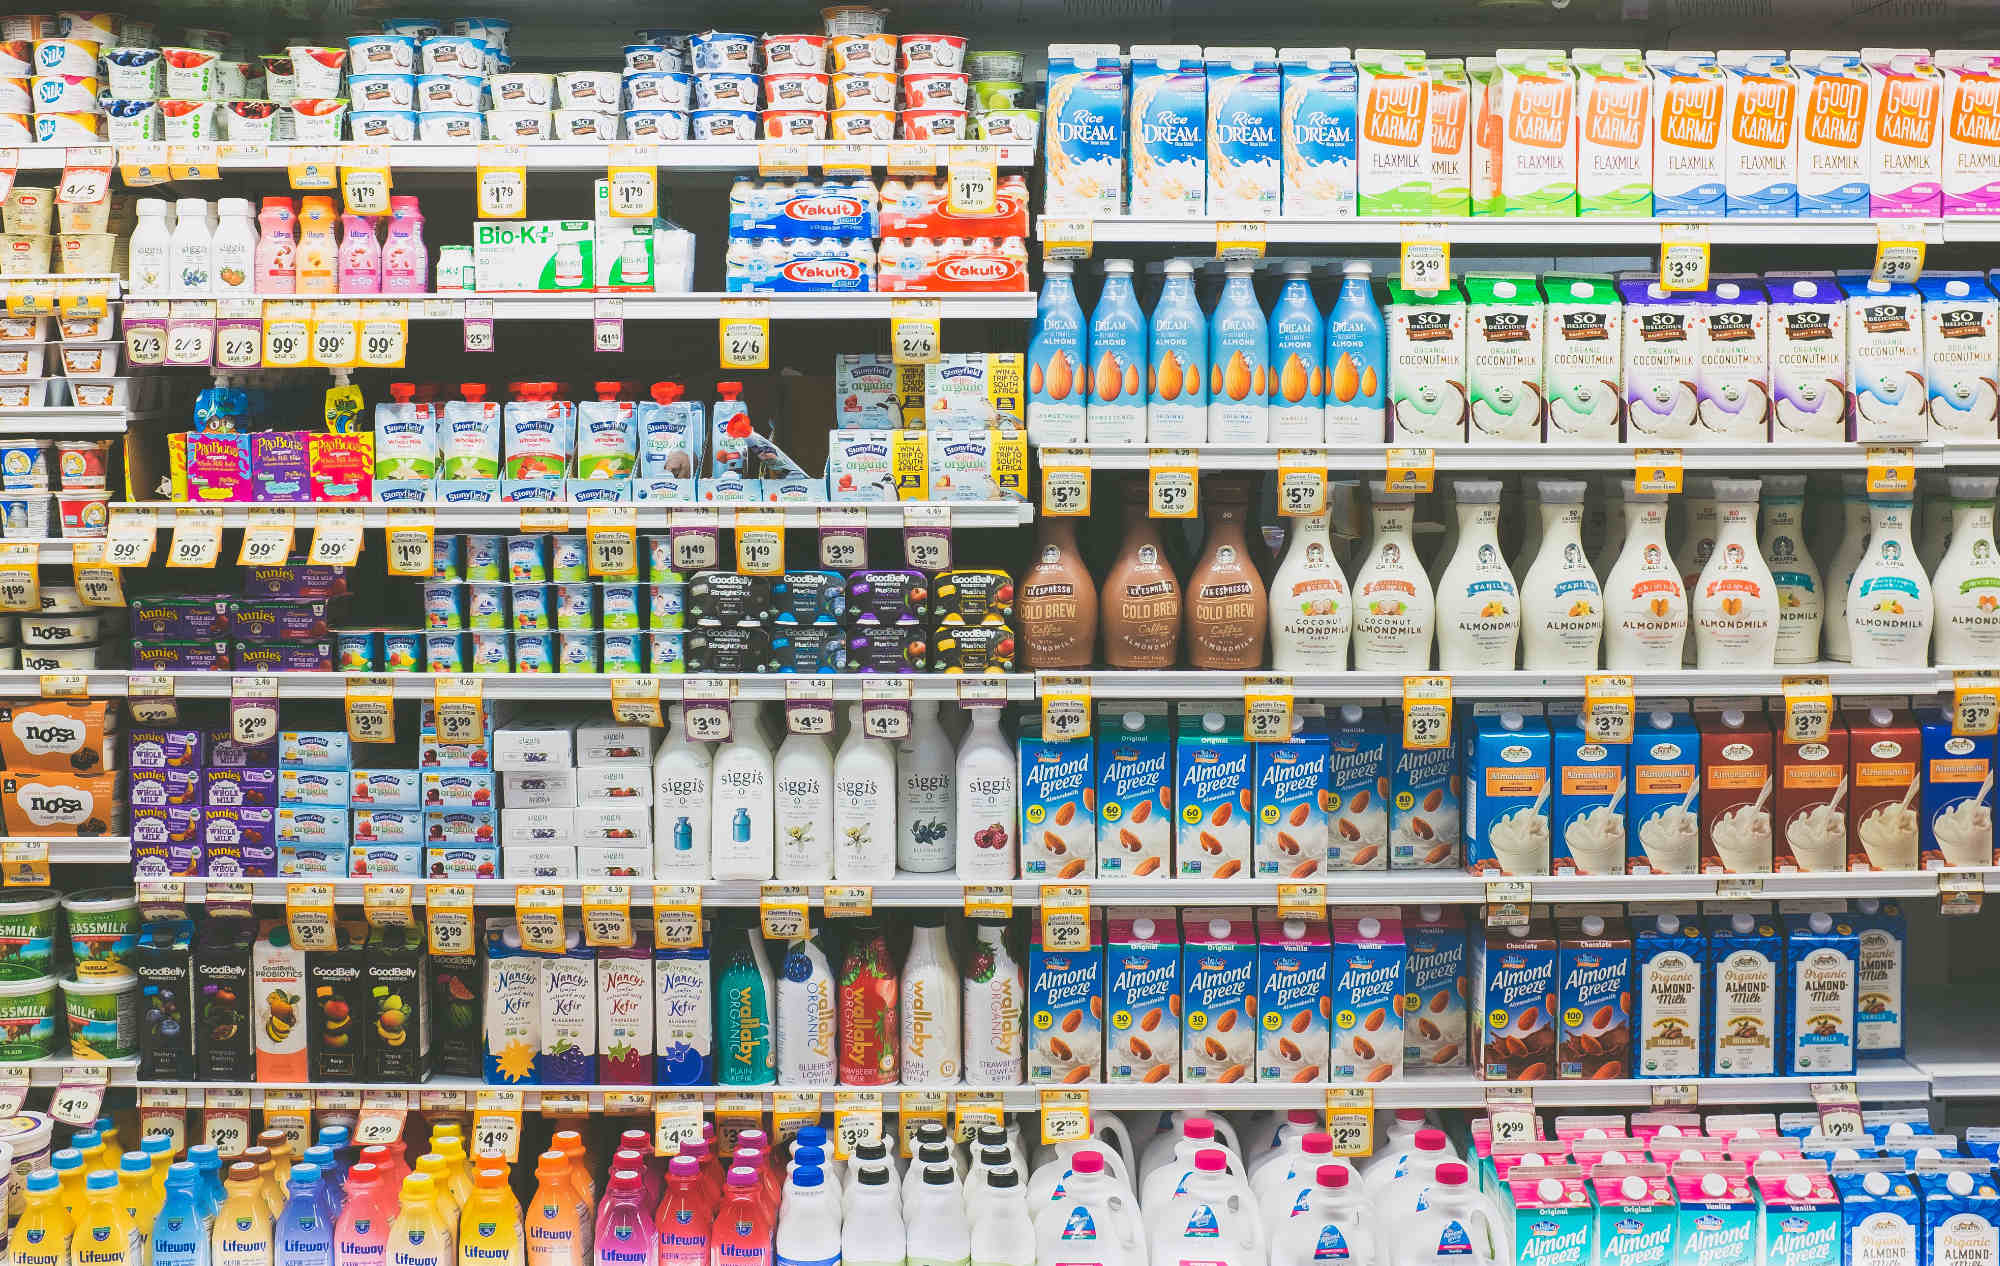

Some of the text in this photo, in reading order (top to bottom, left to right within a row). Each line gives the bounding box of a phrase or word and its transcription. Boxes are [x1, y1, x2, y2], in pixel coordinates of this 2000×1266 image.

[40, 45, 64, 67] Silk
[40, 82, 64, 103] Silk
[1375, 79, 1422, 118] GOOD
[1520, 81, 1564, 118] GOOD
[1672, 80, 1717, 119] GOOD
[1816, 79, 1861, 119] GOOD
[1887, 80, 1932, 119] GOOD
[1073, 110, 1104, 124] Rice
[1157, 111, 1188, 125] Rice
[1231, 111, 1262, 125] Rice
[1307, 111, 1338, 126] Rice
[1370, 116, 1419, 144] KARMA
[1515, 116, 1564, 144] KARMA
[1667, 117, 1714, 145] KARMA
[1811, 117, 1858, 144] KARMA
[1883, 117, 1930, 145] KARMA
[1372, 152, 1420, 169] FLAXMILK
[1517, 155, 1565, 169] FLAXMILK
[1668, 154, 1715, 169] FLAXMILK
[1813, 154, 1859, 169] FLAXMILK
[1884, 154, 1930, 169] FLAXMILK
[797, 203, 850, 216] Yakult
[837, 216, 859, 224] LIGHT
[796, 264, 849, 278] Yakult
[950, 263, 1004, 276] Yakult
[1419, 313, 1442, 324] SO
[1495, 314, 1518, 325] SO
[1720, 313, 1743, 324] SO
[1951, 311, 1974, 322] SO
[1043, 319, 1078, 330] DREAM
[1095, 320, 1126, 331] DREAM
[1279, 322, 1311, 334] DREAM
[1042, 337, 1076, 345] ALMOND
[1094, 338, 1126, 346] ALMOND
[1279, 341, 1312, 349] ALMOND
[1399, 355, 1459, 366] COCONUTMILK
[1476, 355, 1536, 366] COCONUTMILK
[1701, 355, 1762, 365] COCONUTMILK
[1778, 354, 1839, 365] COCONUTMILK
[941, 367, 983, 379] Stonyfield
[384, 422, 424, 434] Stonyfield
[515, 422, 553, 434] Stonyfield
[846, 445, 888, 457] Stonyfield
[943, 444, 986, 456] Stonyfield
[255, 568, 295, 583] Annie's
[708, 574, 752, 586] GoodBelly
[866, 573, 910, 584] GoodBelly
[951, 575, 995, 586] GoodBelly
[139, 606, 178, 621] Annie's
[236, 609, 275, 624] Annie's
[1020, 603, 1077, 619] COLD BREW
[1122, 602, 1178, 618] COLD BREW
[1197, 603, 1255, 619] COLD BREW
[1357, 625, 1422, 635] ALMONDMILK
[1699, 619, 1768, 629] ALMONDMILK
[32, 624, 71, 639] noosa
[951, 629, 996, 639] GoodBelly
[26, 726, 76, 743] noosa
[1121, 735, 1148, 743] Original
[208, 770, 241, 782] Annie's
[1026, 753, 1089, 786] Almond
[1183, 753, 1245, 787] Almond
[1261, 755, 1324, 788] Almond
[211, 789, 239, 797] WHOLE
[1040, 773, 1083, 799] Breeze
[1196, 774, 1240, 800] Breeze
[1275, 773, 1319, 800] Breeze
[31, 796, 82, 814] noosa
[1030, 809, 1042, 817] 60
[1263, 809, 1276, 817] 80
[1506, 942, 1538, 950] Chocolate
[139, 966, 186, 977] GoodBelly
[369, 967, 416, 978] GoodBelly
[1034, 962, 1097, 993] Almond
[1190, 961, 1252, 993] Almond
[1490, 960, 1553, 991] Almond
[1650, 971, 1693, 983] Organic
[1804, 969, 1847, 980] Organic
[1047, 981, 1091, 1006] Breeze
[1203, 981, 1246, 1006] Breeze
[1504, 981, 1546, 1004] Breeze
[1657, 992, 1687, 1004] Milk
[502, 999, 530, 1016] Kefir
[612, 999, 638, 1016] Kefir
[727, 988, 741, 1056] ORGANIC
[846, 986, 855, 1057] ORGANIC
[1037, 1015, 1049, 1023] 30
[1492, 1014, 1506, 1022] 100
[740, 986, 760, 1065] wallaby
[852, 986, 873, 1066] wallaby
[1791, 1204, 1817, 1212] Vanilla
[531, 1226, 572, 1240] Lifeway
[155, 1240, 195, 1254] Lifeway
[223, 1240, 266, 1253] Lifeway
[661, 1233, 706, 1248] Lifeway
[1521, 1224, 1587, 1261] Almond
[465, 1245, 509, 1259] Lifeway
